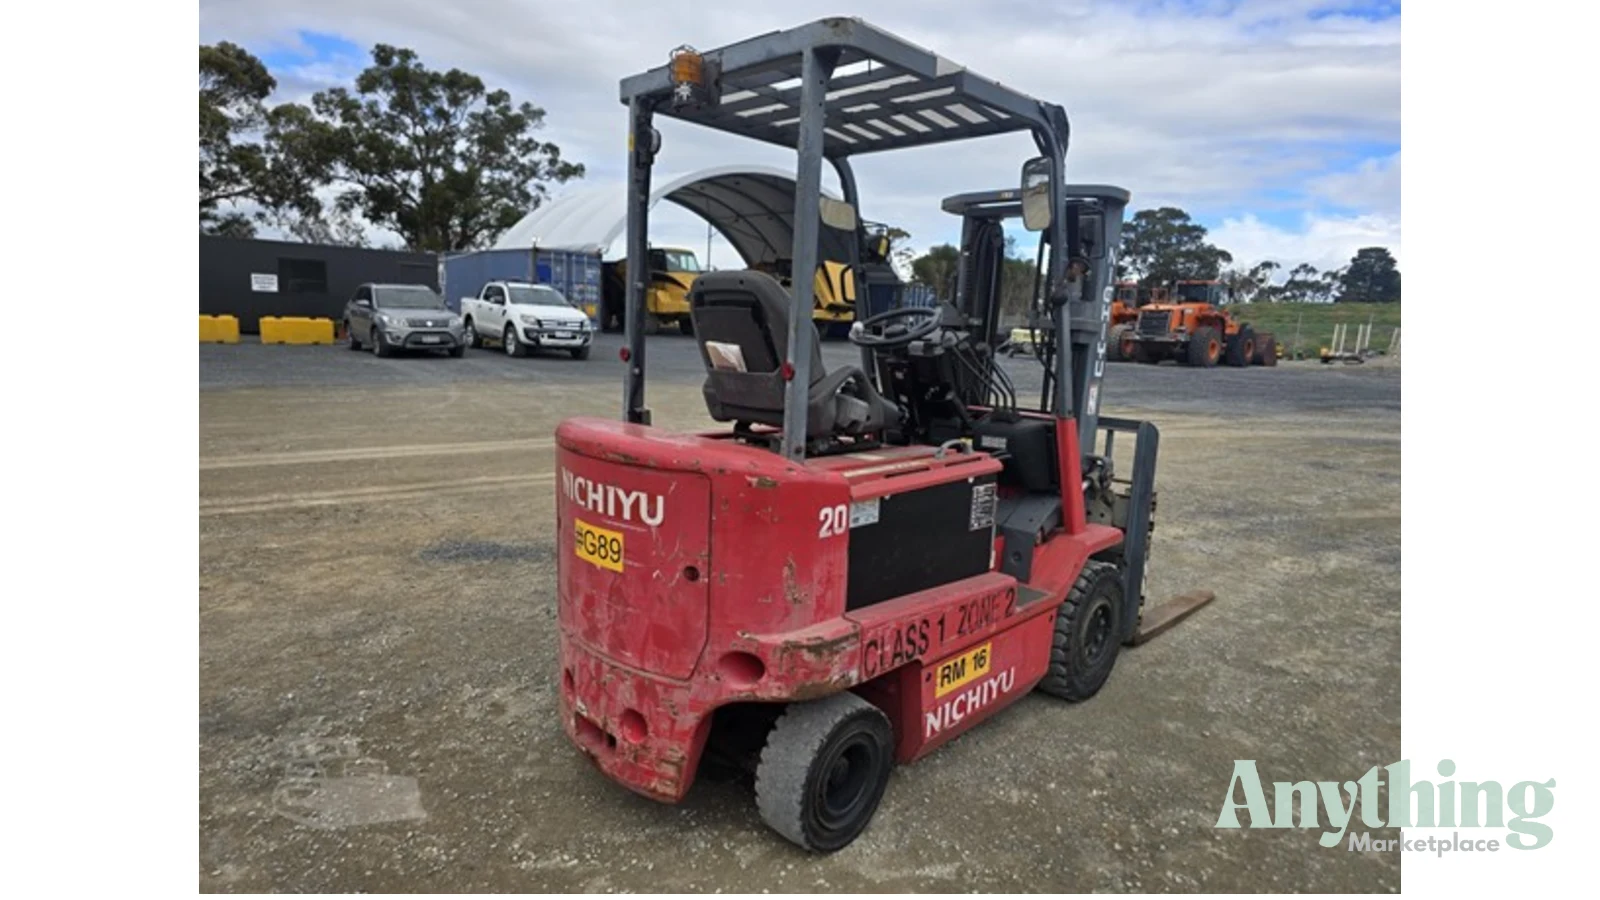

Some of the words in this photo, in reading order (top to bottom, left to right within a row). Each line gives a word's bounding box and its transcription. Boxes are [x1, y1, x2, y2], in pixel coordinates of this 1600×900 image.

[1094, 247, 1118, 377] NICHIYU
[561, 466, 664, 526] NICHIYU
[819, 504, 848, 539] 20
[575, 526, 622, 564] #G89
[864, 619, 931, 678] CLASS
[937, 612, 946, 643] 1
[957, 593, 1000, 637] ZONE
[1004, 587, 1016, 618] 2
[940, 658, 966, 688] RM
[972, 649, 988, 671] 16
[925, 667, 1016, 738] NICHIYU
